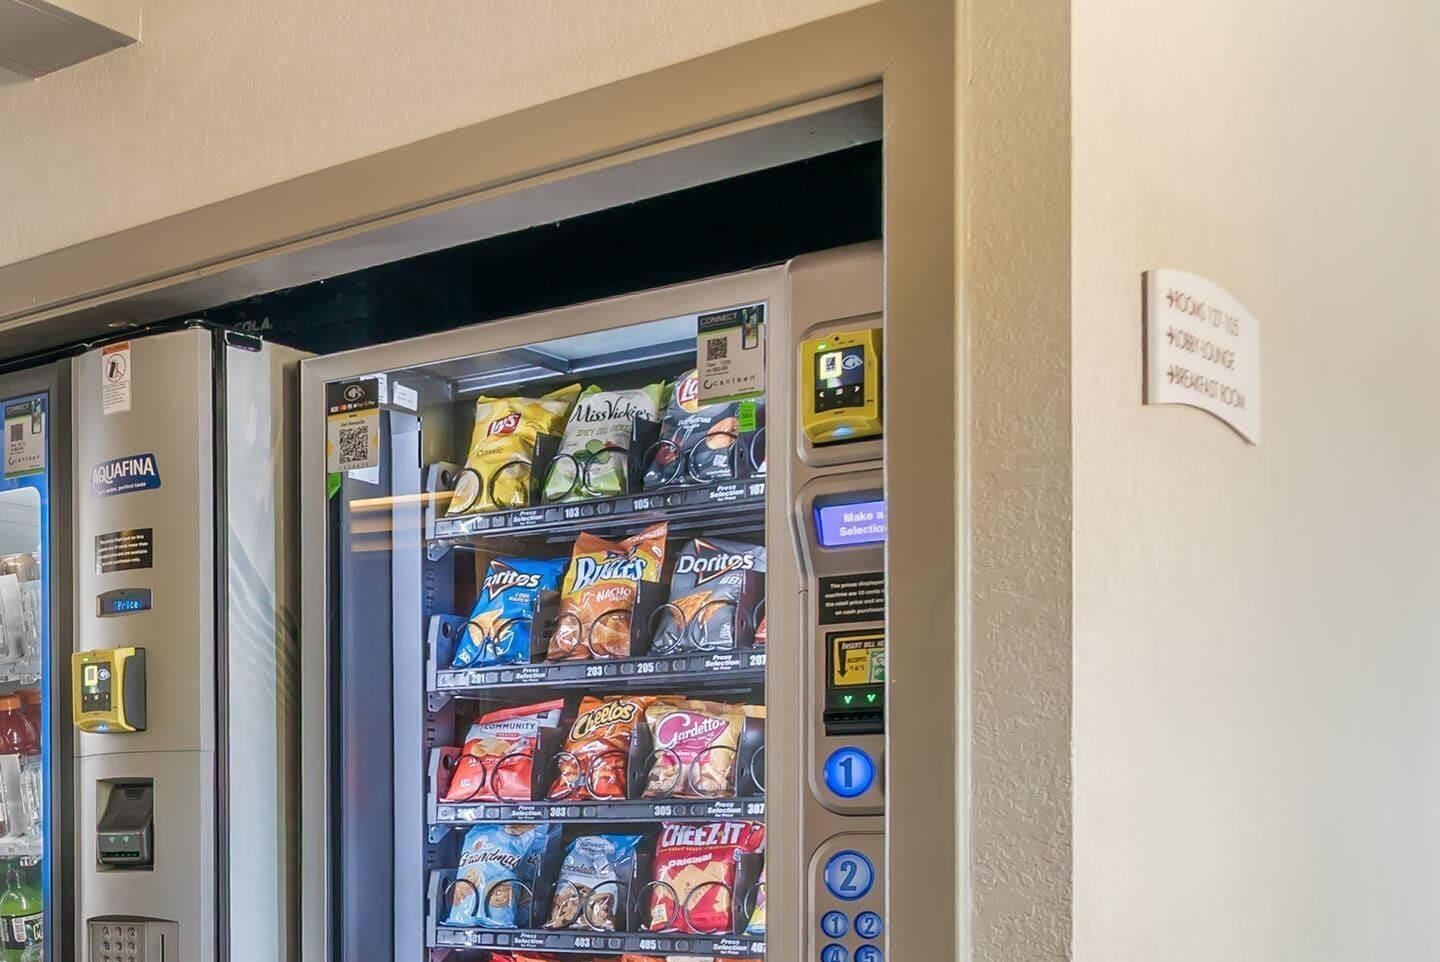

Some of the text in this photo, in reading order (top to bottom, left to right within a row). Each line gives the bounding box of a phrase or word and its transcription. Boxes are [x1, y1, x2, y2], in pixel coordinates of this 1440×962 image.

[1174, 364, 1245, 407] BREAKFAST ROOM
[569, 396, 650, 423] Miss Vickie's
[477, 447, 504, 457] Classic
[93, 457, 155, 489] AQUAFINA
[710, 490, 744, 498] Selection
[748, 484, 765, 496] 107
[634, 498, 649, 510] 105
[565, 508, 580, 518] 103
[844, 511, 884, 523] Make a
[676, 552, 755, 574] Doritos
[596, 587, 631, 602] NACHO
[842, 641, 863, 650] INSERT
[586, 666, 602, 676] 203
[637, 662, 654, 674] 205
[484, 721, 536, 731] COMMUNITY
[572, 701, 633, 740] Cheetos
[838, 757, 853, 788] 1
[550, 807, 566, 816] 303
[654, 806, 672, 816] 305
[748, 804, 764, 814] 307
[840, 860, 858, 892] 2
[832, 916, 875, 935] 1 2
[574, 938, 590, 948] 403
[640, 940, 656, 950] 405
